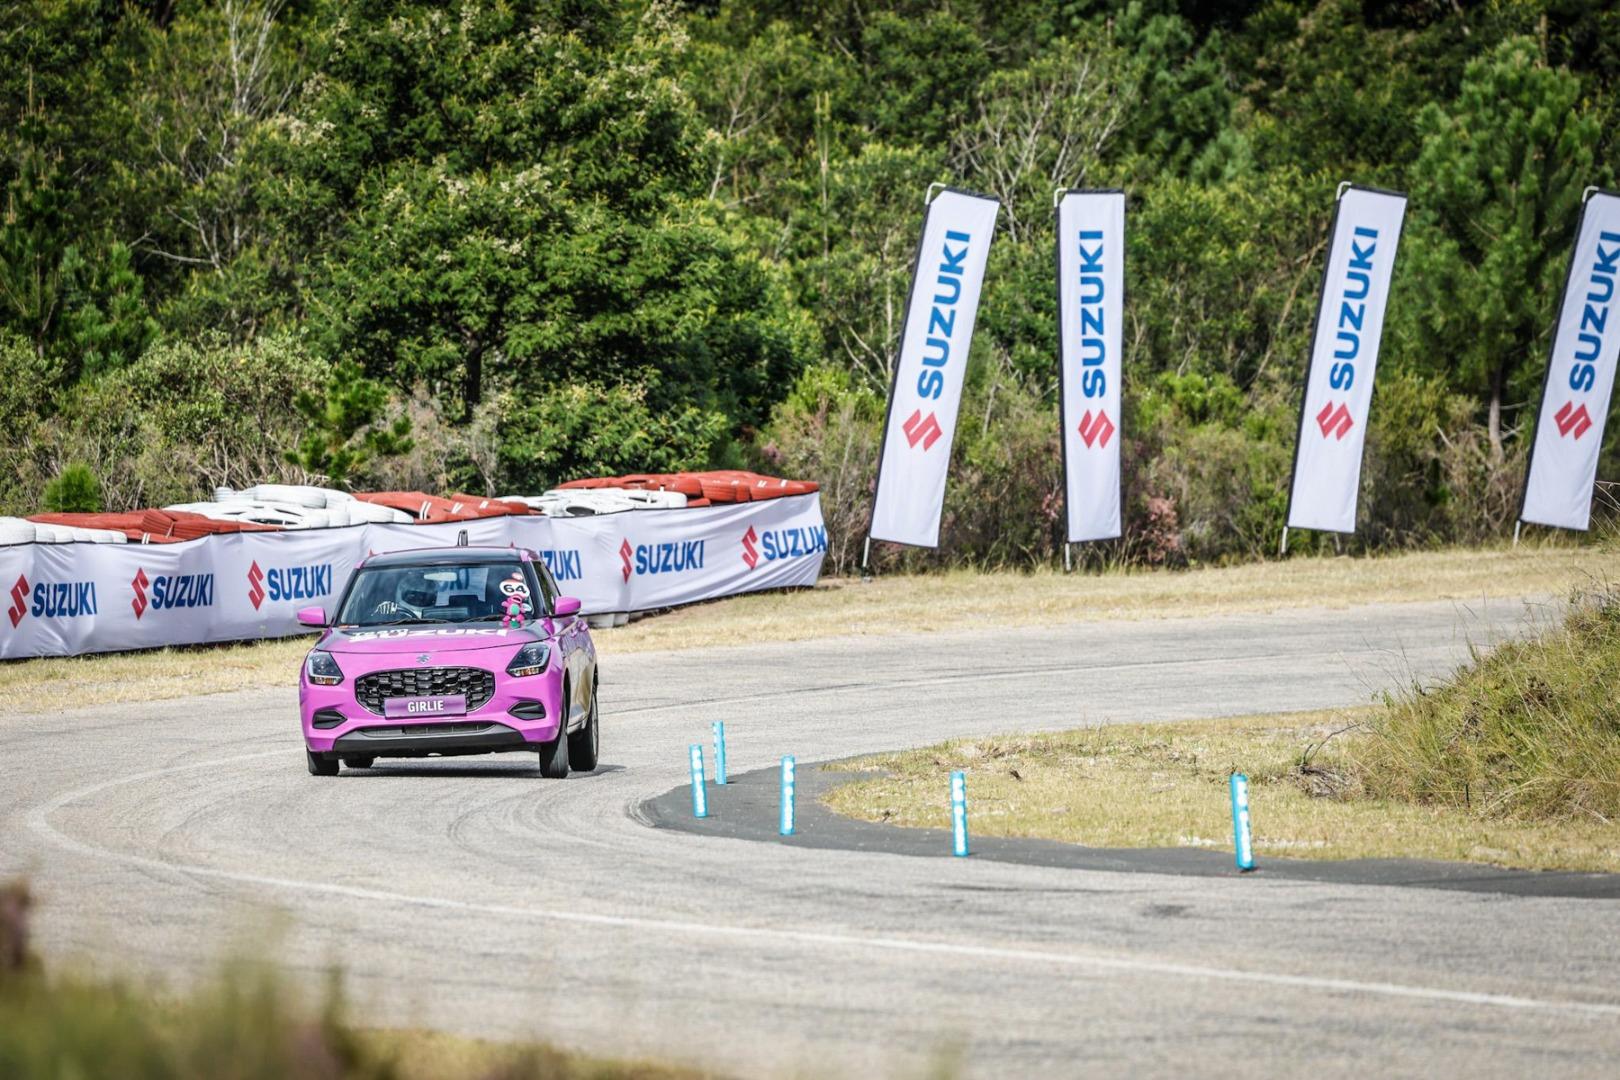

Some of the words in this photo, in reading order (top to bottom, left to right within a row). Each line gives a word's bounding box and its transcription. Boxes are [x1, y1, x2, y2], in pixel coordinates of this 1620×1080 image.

[917, 230, 971, 400] SUZUKI
[1079, 230, 1106, 399] SUZUKI
[1329, 226, 1379, 391] SUZUKI
[1568, 230, 1620, 393] SUZUKI
[635, 540, 704, 576] SUZUKI
[761, 525, 828, 561] SUZUK
[267, 564, 332, 602] SUZUKI
[539, 550, 582, 581] ZUKI
[31, 581, 98, 618] SUZUKI
[151, 574, 213, 609] SUZUKI
[503, 583, 527, 594] 64
[407, 700, 444, 713] GIRLIE
